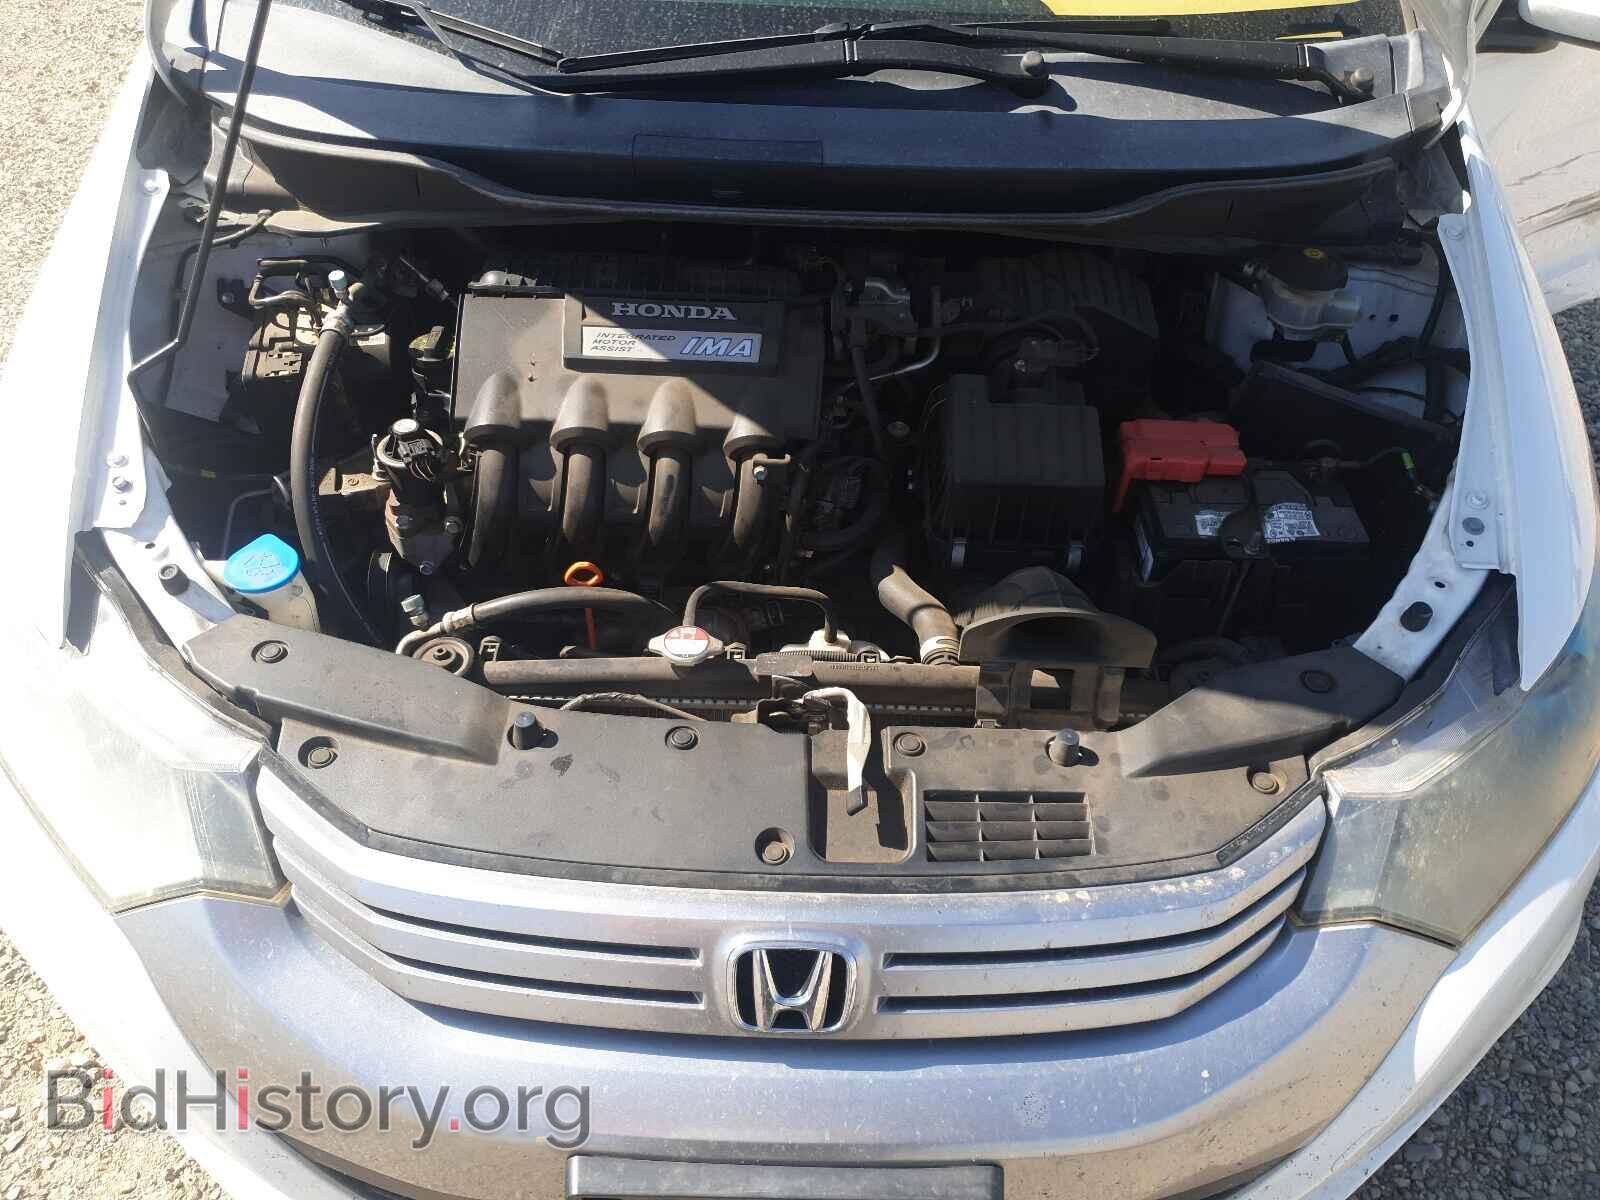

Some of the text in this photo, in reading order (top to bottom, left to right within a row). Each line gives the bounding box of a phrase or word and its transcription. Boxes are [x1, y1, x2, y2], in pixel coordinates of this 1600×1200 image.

[612, 302, 737, 320] HONDA
[596, 332, 676, 341] INTEGRATED
[680, 336, 753, 357] IMA
